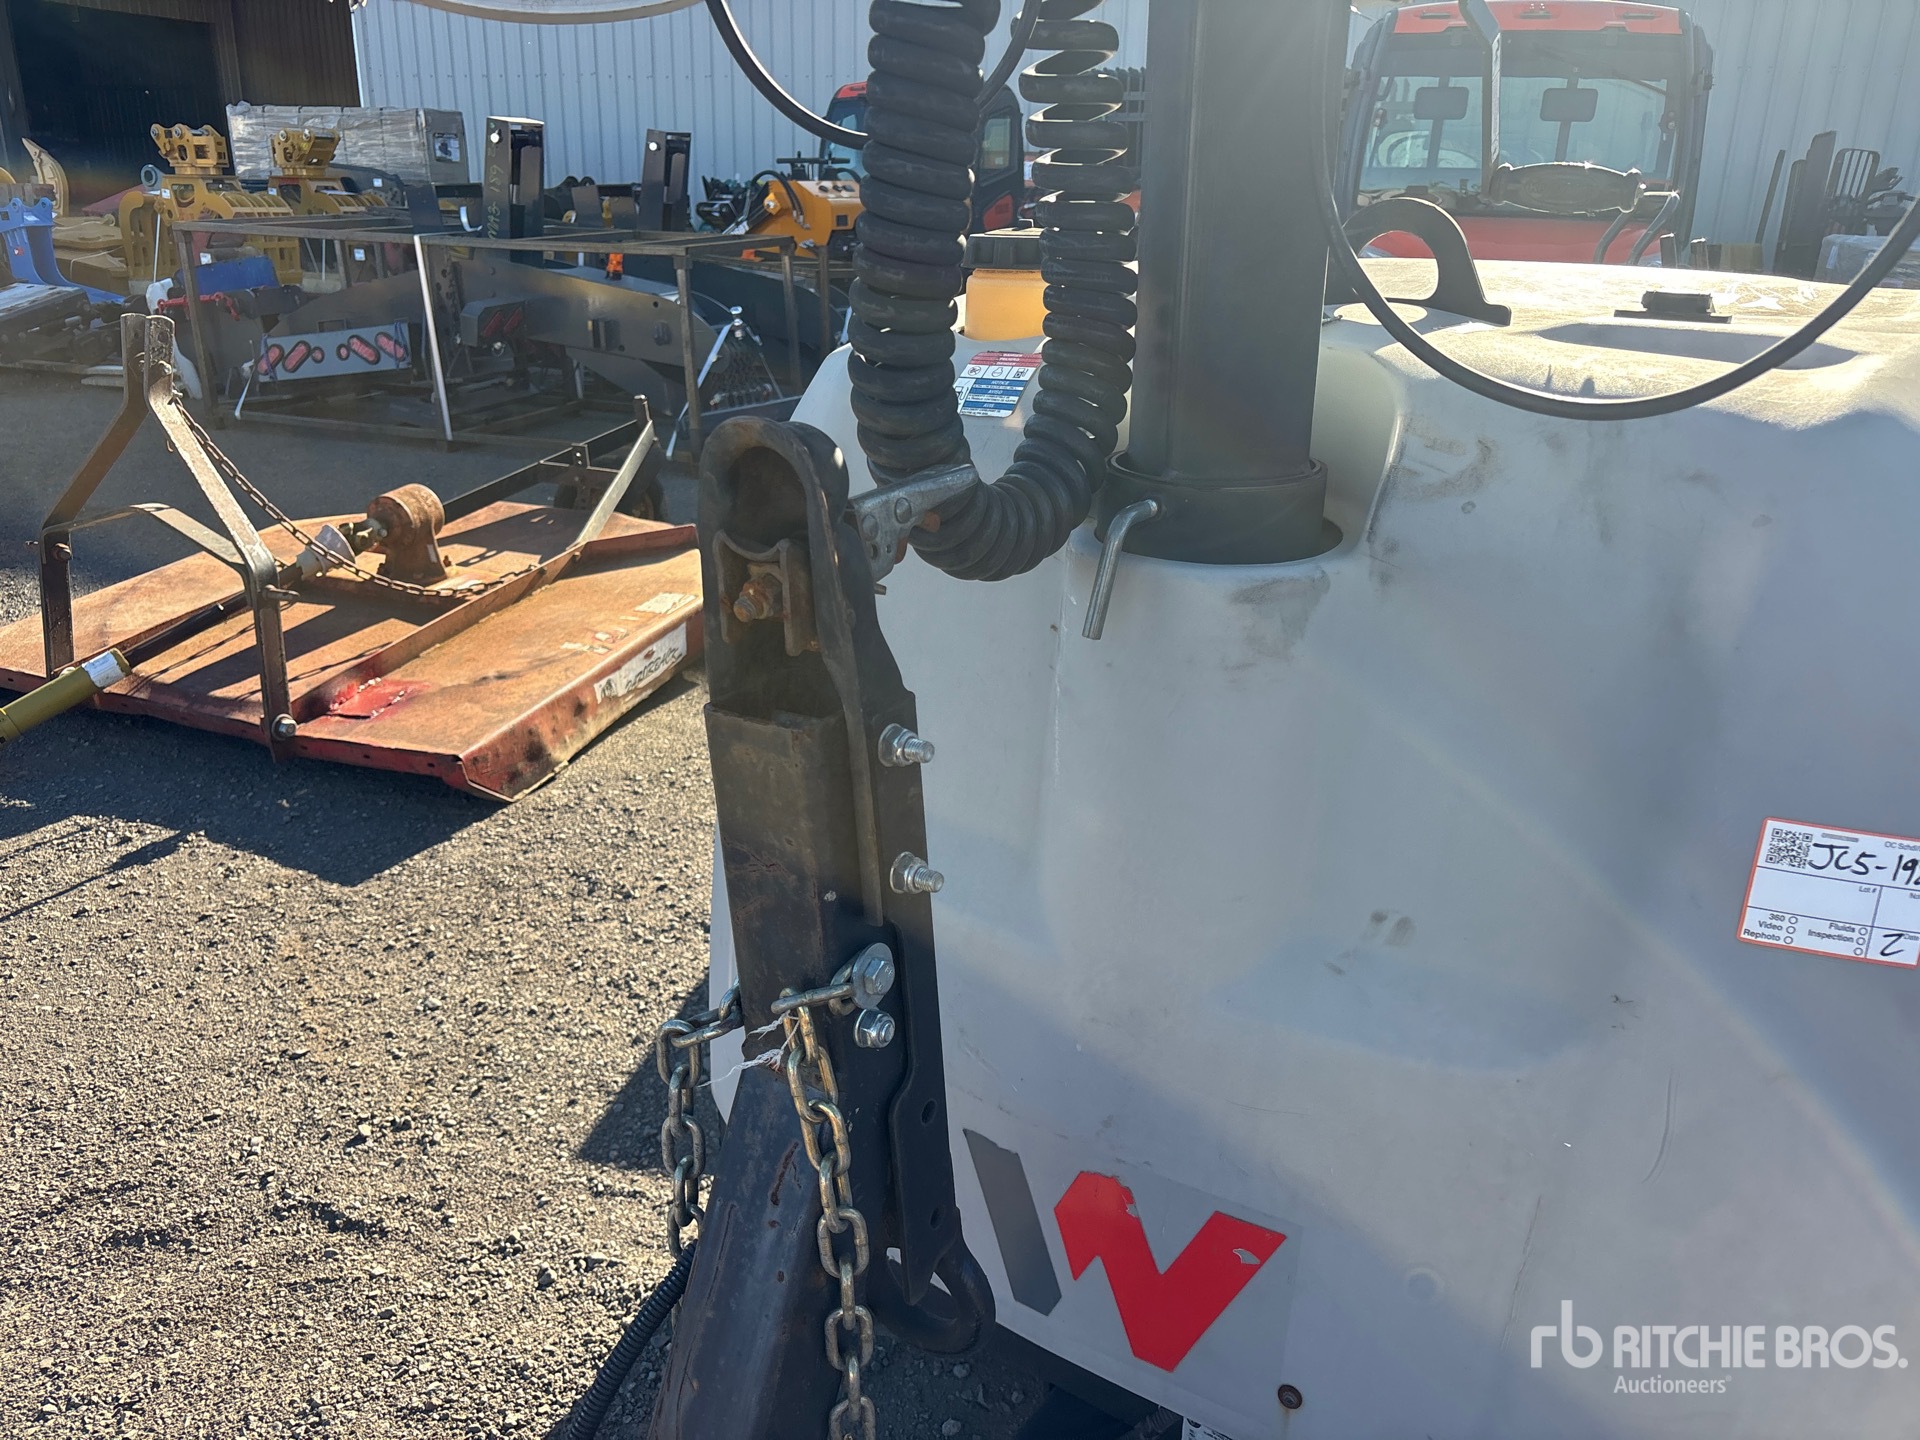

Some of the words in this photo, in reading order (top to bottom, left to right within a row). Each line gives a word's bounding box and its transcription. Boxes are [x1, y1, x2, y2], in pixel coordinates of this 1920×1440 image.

[1768, 913, 1786, 922] 360
[1758, 920, 1783, 931] Video
[1829, 922, 1856, 933] Fluids
[1743, 928, 1781, 942] Rephoto
[1808, 929, 1855, 944] Inspection
